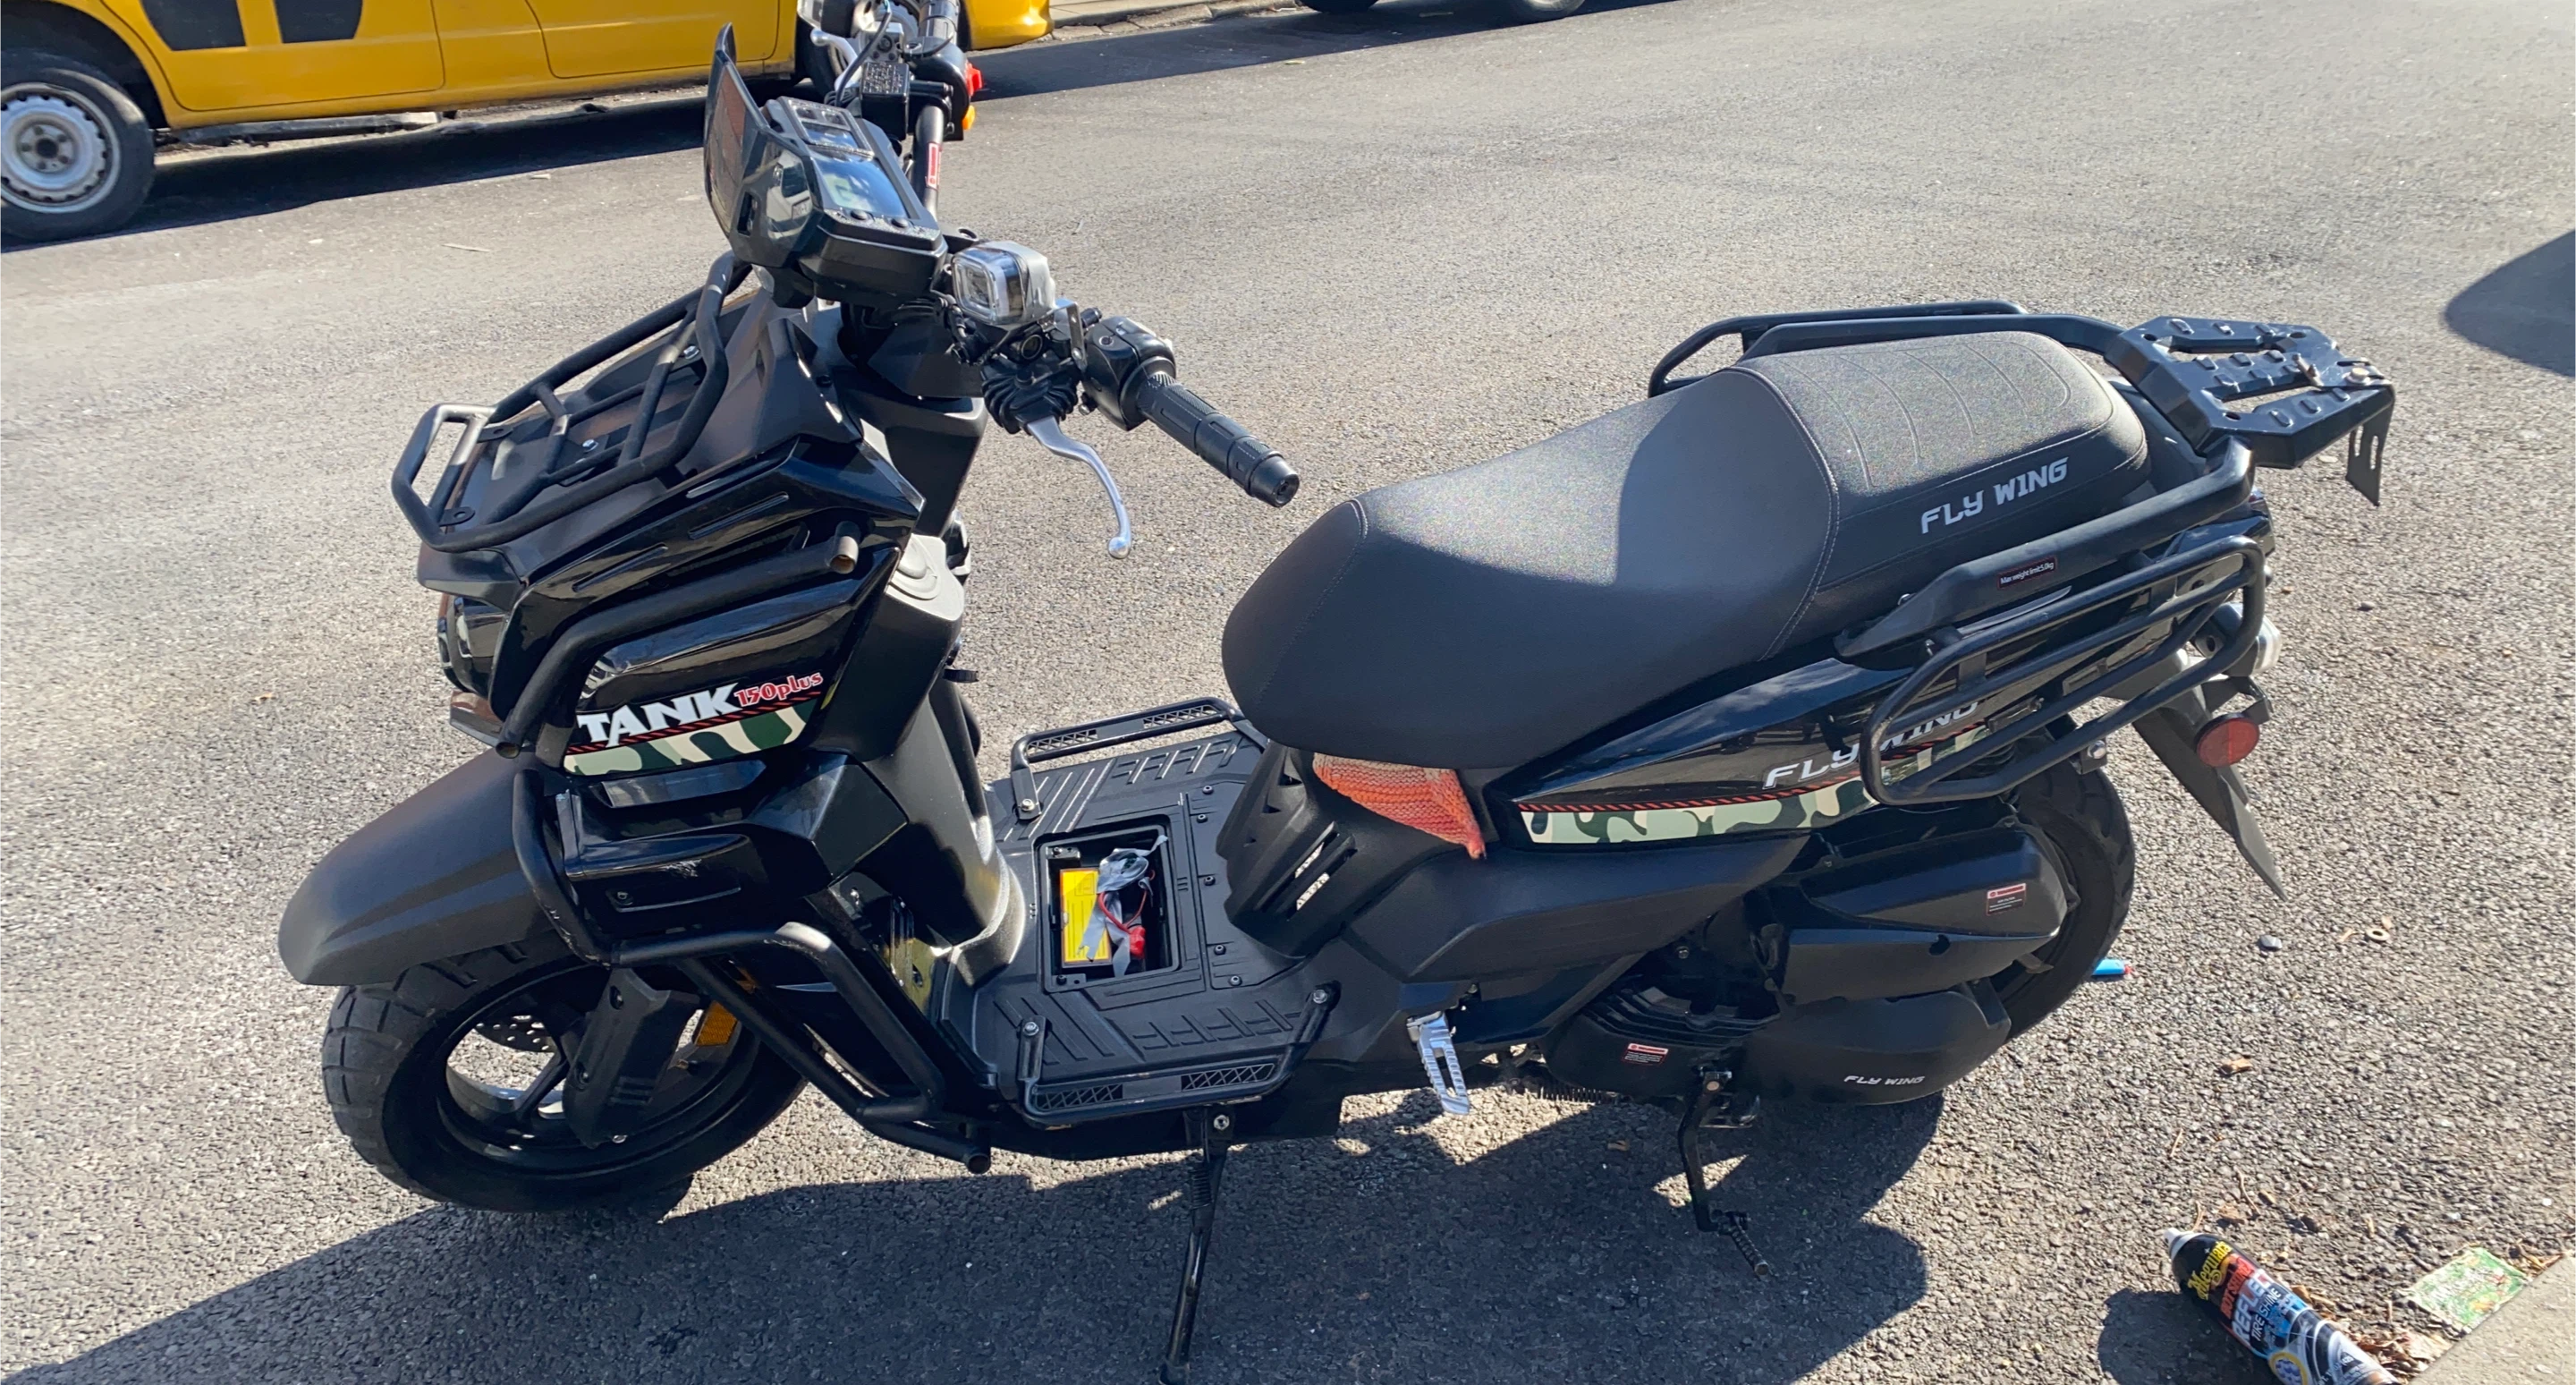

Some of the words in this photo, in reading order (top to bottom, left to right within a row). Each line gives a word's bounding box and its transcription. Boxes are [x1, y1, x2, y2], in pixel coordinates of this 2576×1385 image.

[1920, 489, 1984, 534] FLY
[1993, 456, 2069, 506] WING
[576, 682, 744, 749] TANK
[733, 672, 824, 707] 150plus
[1764, 743, 1860, 789] FLY
[1843, 1075, 1882, 1085] FLY
[1884, 1076, 1925, 1085] WING
[2251, 1314, 2266, 1342] TIRE
[2259, 1287, 2282, 1318] SHINE
